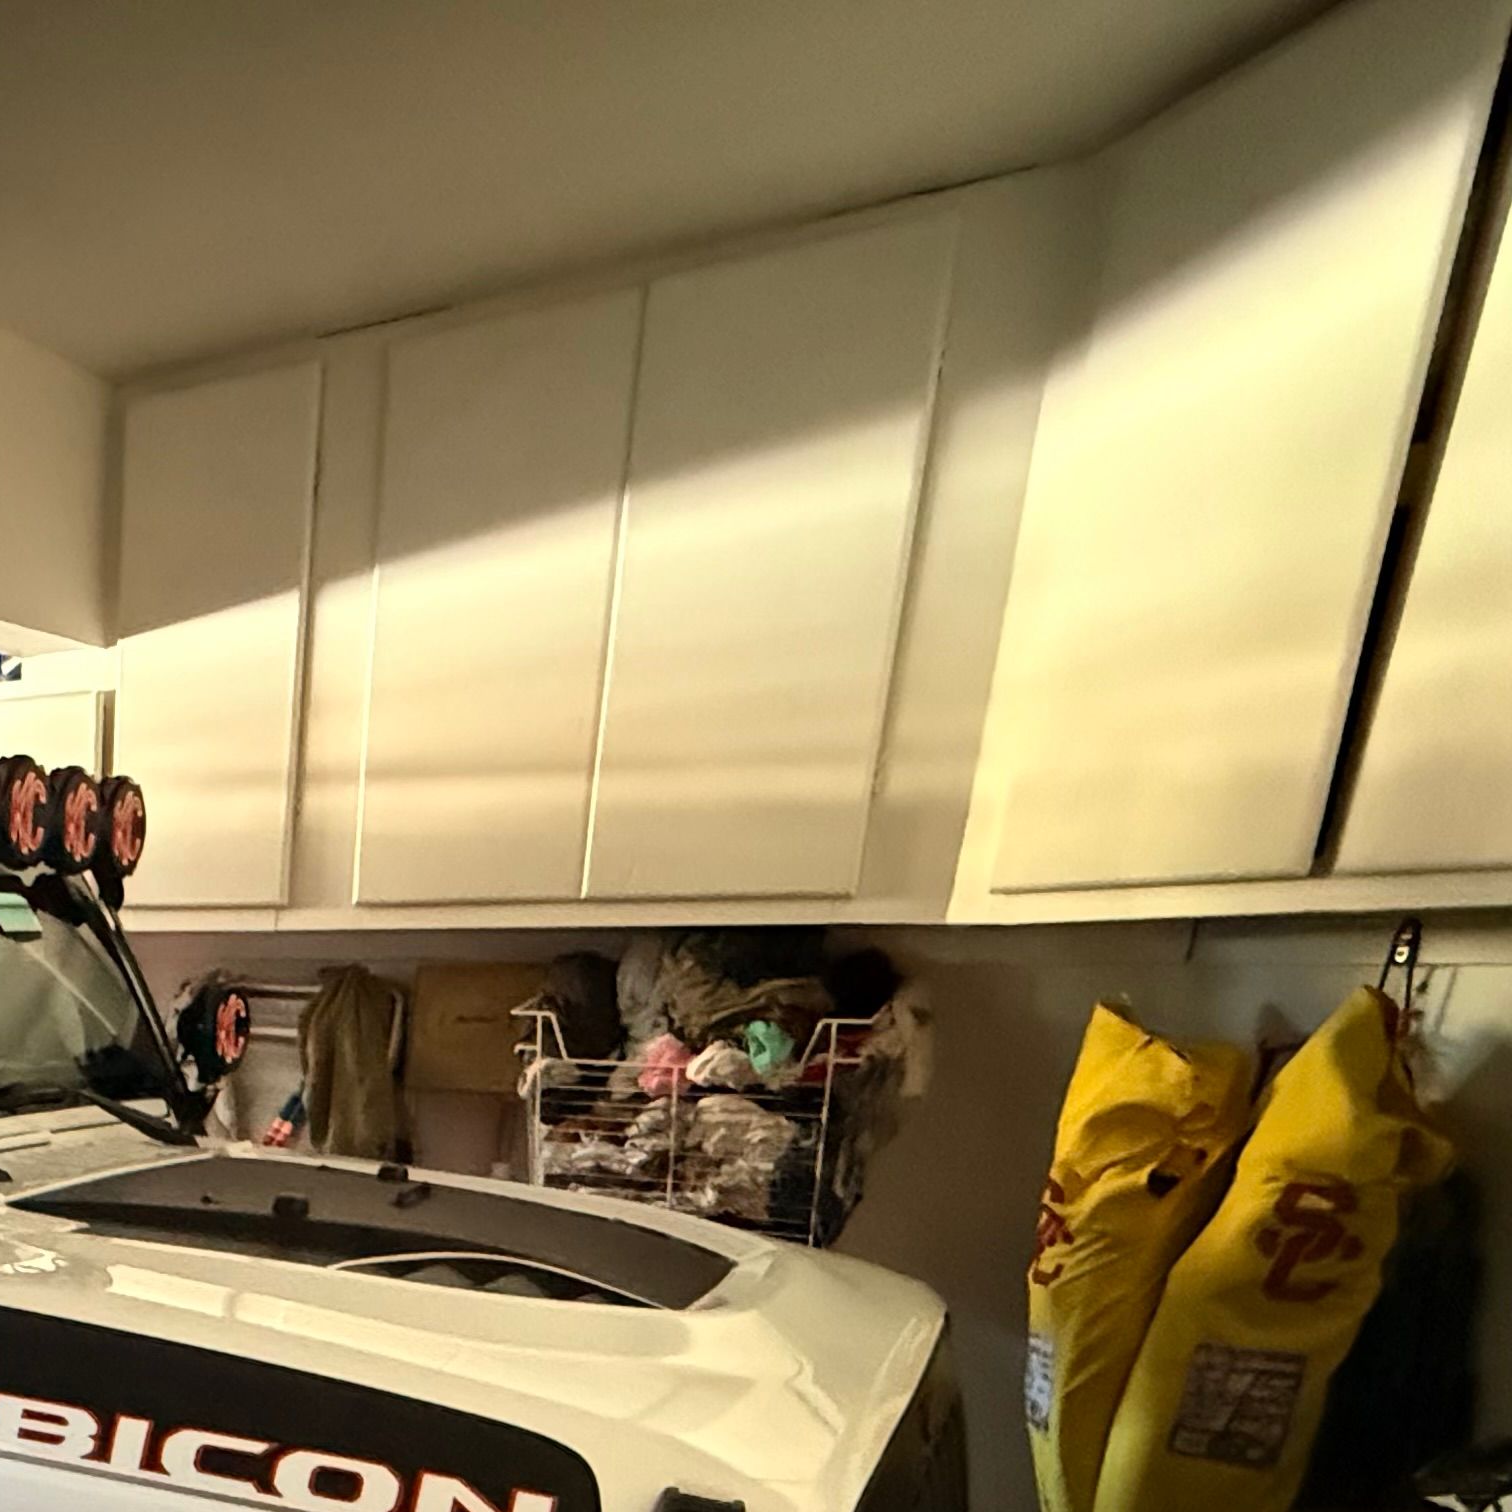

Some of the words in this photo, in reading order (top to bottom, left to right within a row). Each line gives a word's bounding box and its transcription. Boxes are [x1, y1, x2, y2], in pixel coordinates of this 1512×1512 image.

[9, 771, 47, 854] KC
[64, 782, 97, 861] KC
[112, 791, 143, 865] KC
[216, 993, 246, 1063] KC
